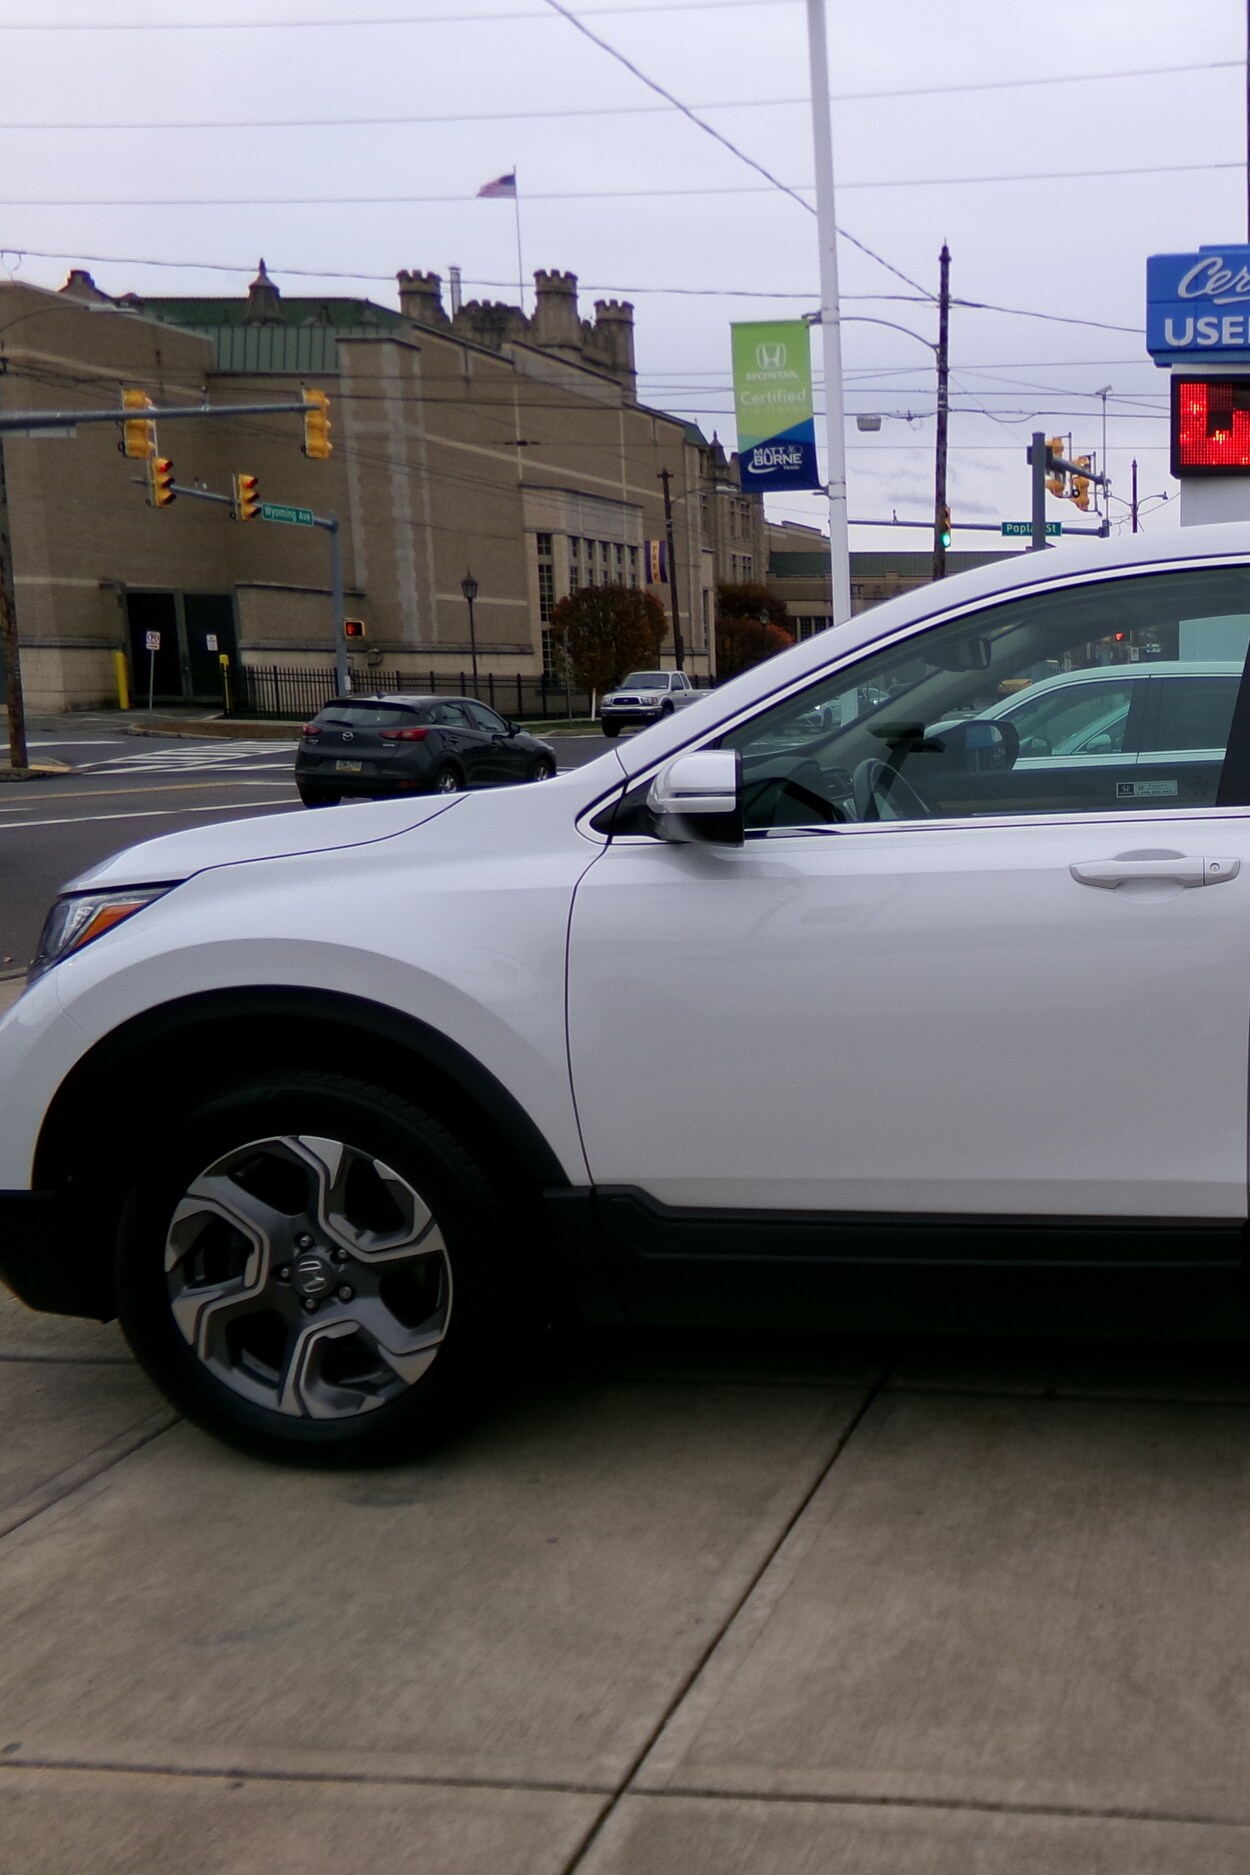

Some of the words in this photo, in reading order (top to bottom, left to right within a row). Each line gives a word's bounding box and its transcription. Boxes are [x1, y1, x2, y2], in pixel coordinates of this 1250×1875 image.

[745, 370, 799, 381] HONDA
[740, 387, 806, 405] Certified
[753, 447, 785, 455] MATT
[754, 453, 803, 466] BURNE
[264, 504, 297, 522] Wyoming
[299, 511, 311, 522] Ave
[1006, 523, 1033, 535] Popl
[1046, 523, 1057, 533] St
